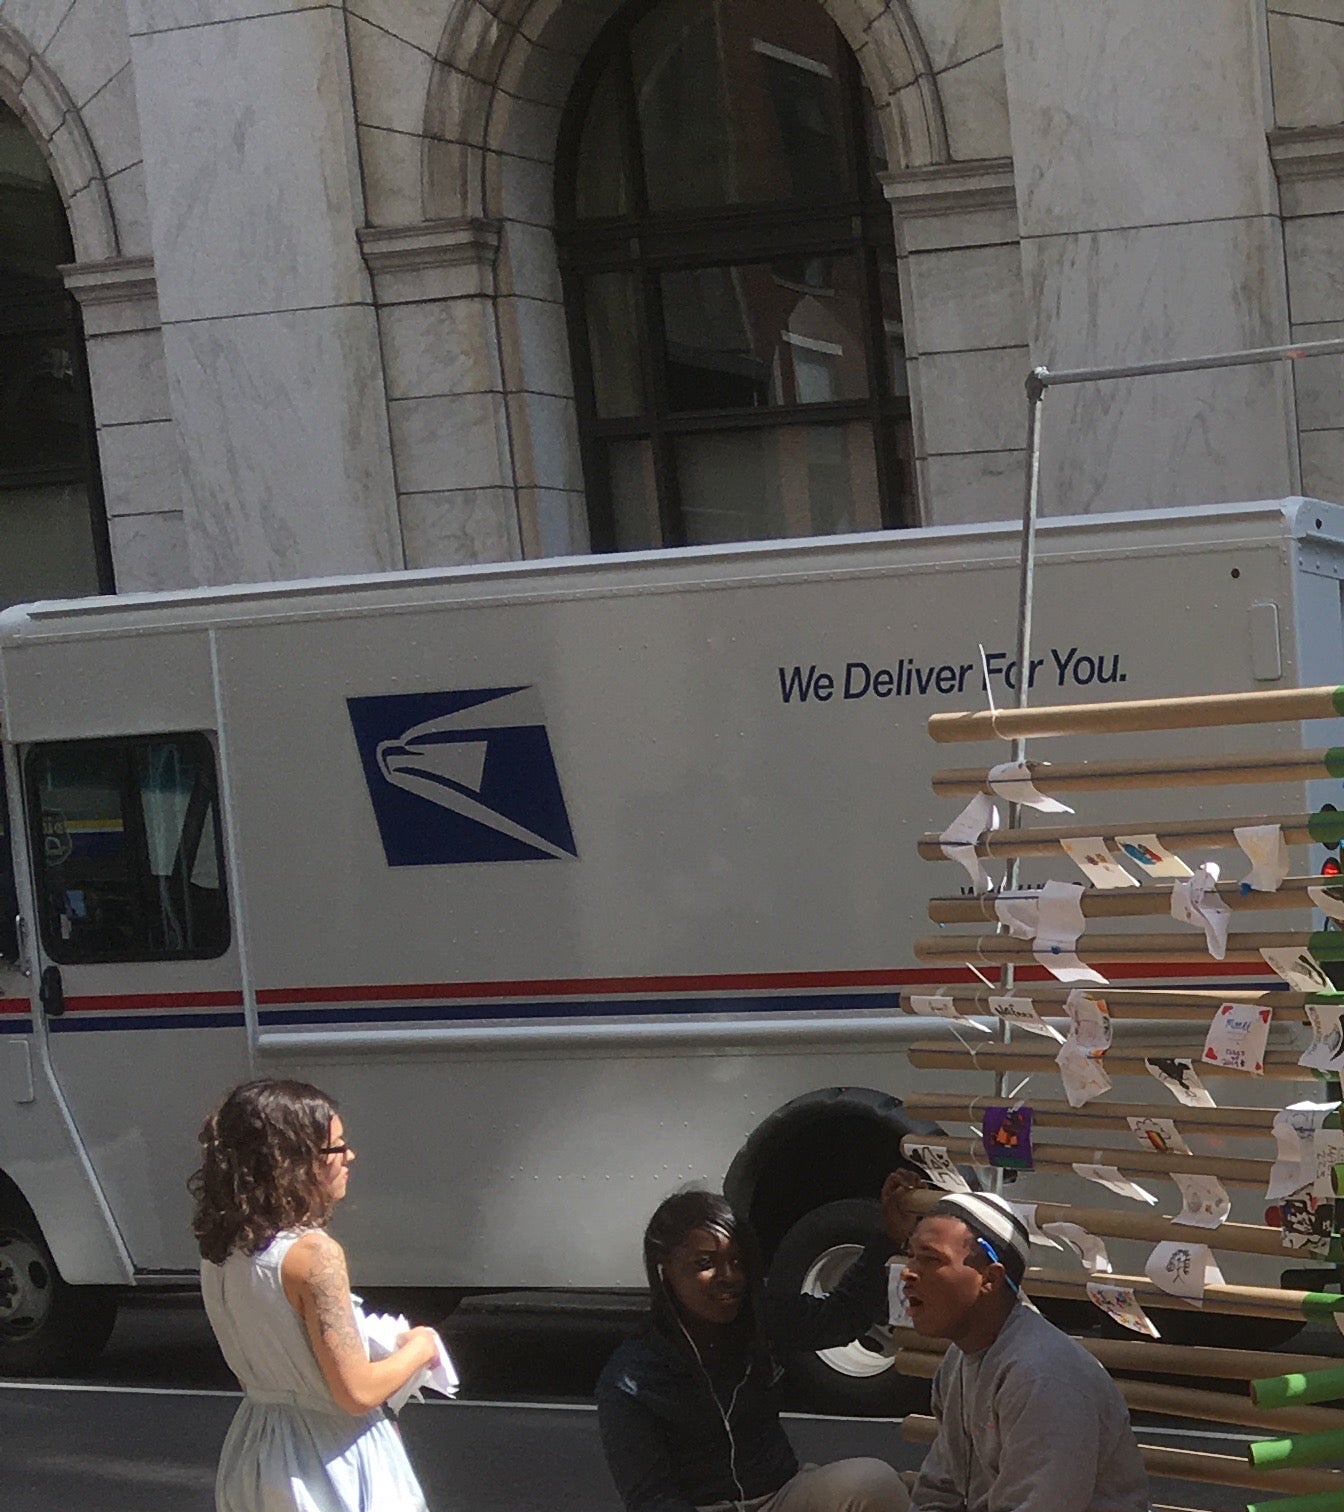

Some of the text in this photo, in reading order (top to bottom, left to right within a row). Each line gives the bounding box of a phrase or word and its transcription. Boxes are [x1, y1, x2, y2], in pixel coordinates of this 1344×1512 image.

[778, 646, 1128, 704] We Deliver For You.
